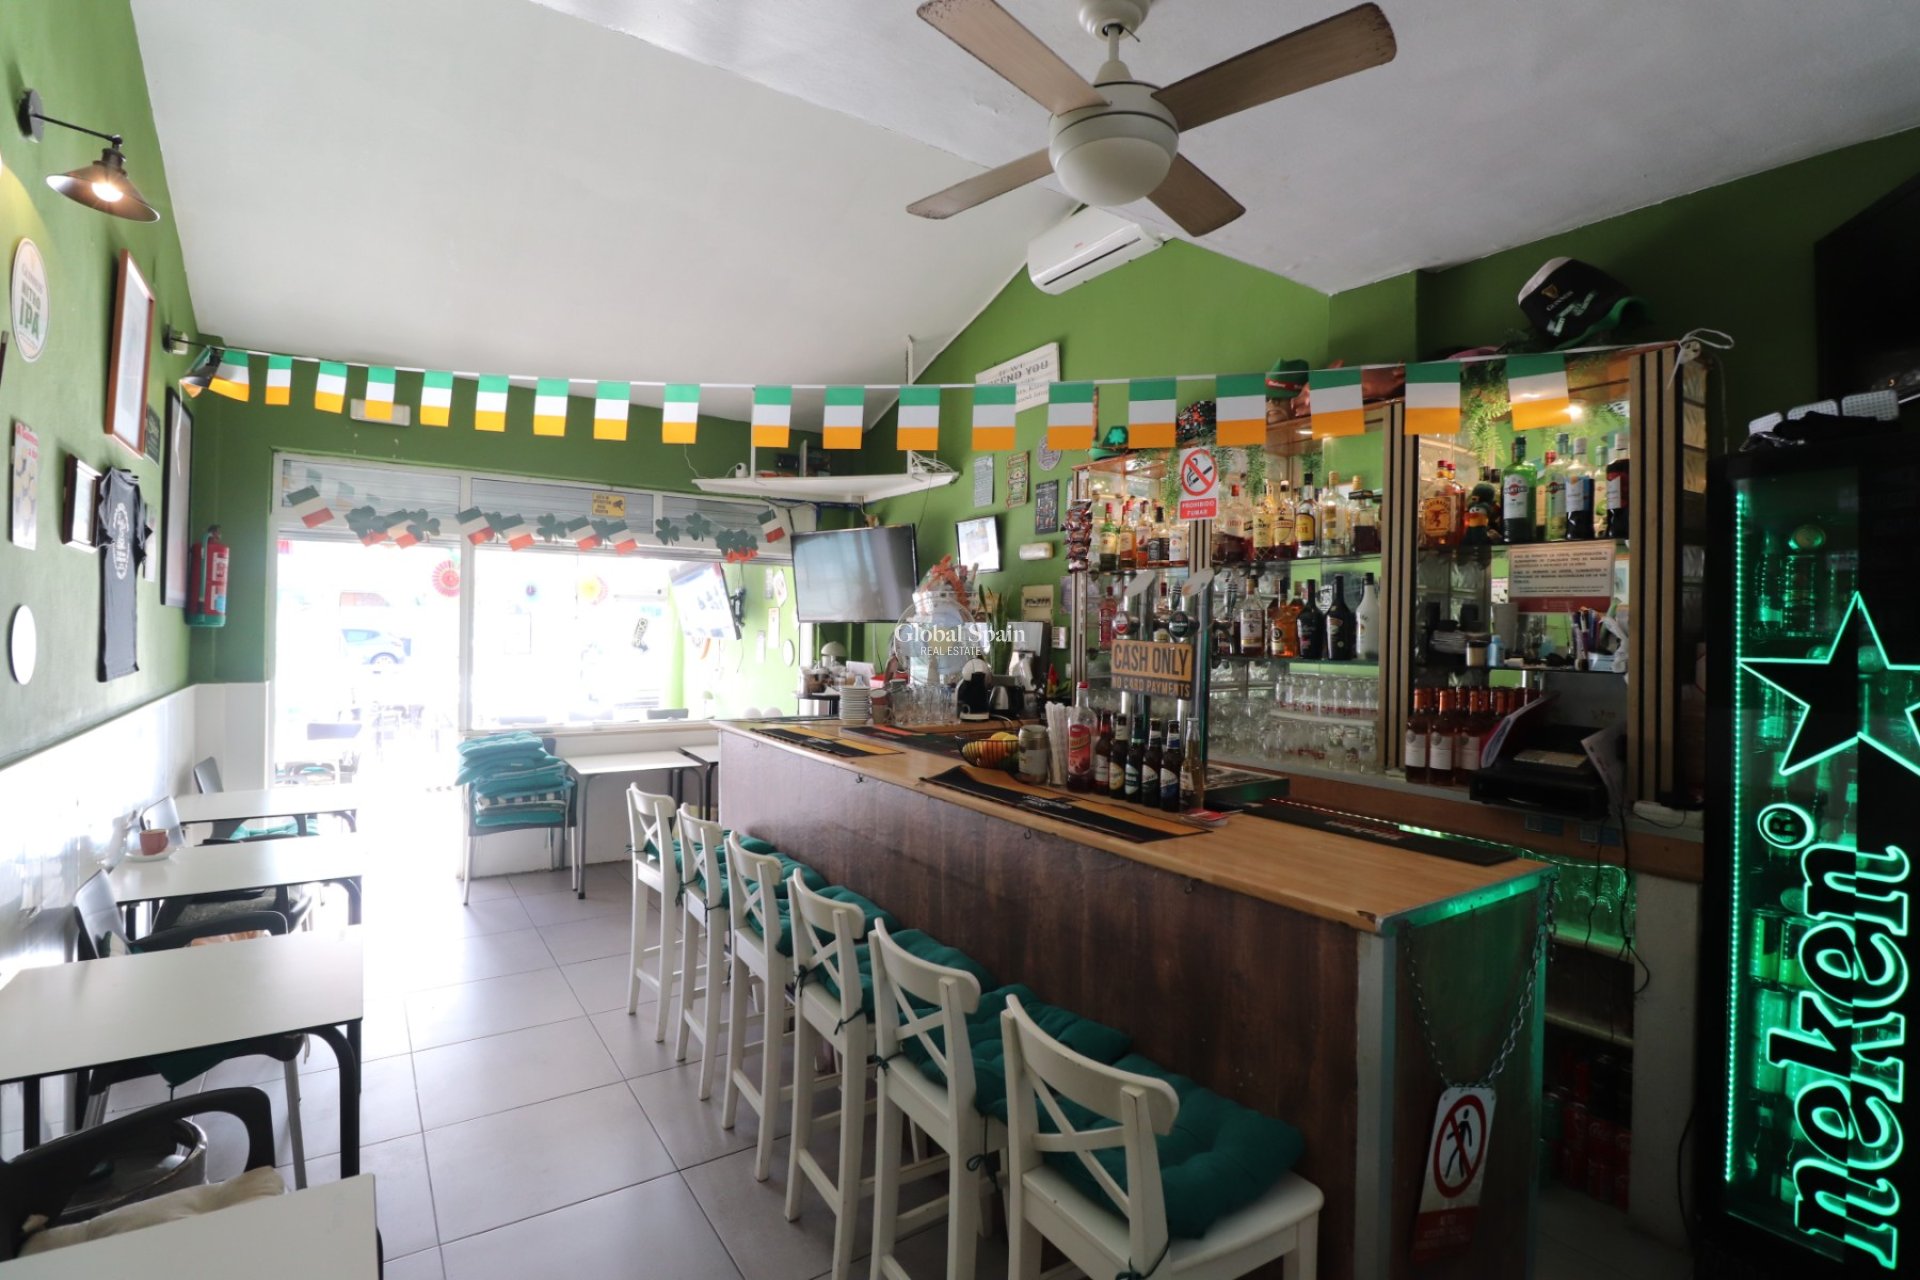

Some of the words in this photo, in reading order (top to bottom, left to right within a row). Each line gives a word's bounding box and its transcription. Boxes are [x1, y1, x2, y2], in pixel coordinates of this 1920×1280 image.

[19, 297, 40, 340] IPA
[1025, 360, 1049, 375] YOU
[1113, 643, 1148, 672] CASH
[1152, 647, 1189, 676] ONLY
[1146, 679, 1191, 698] PAYMENTS
